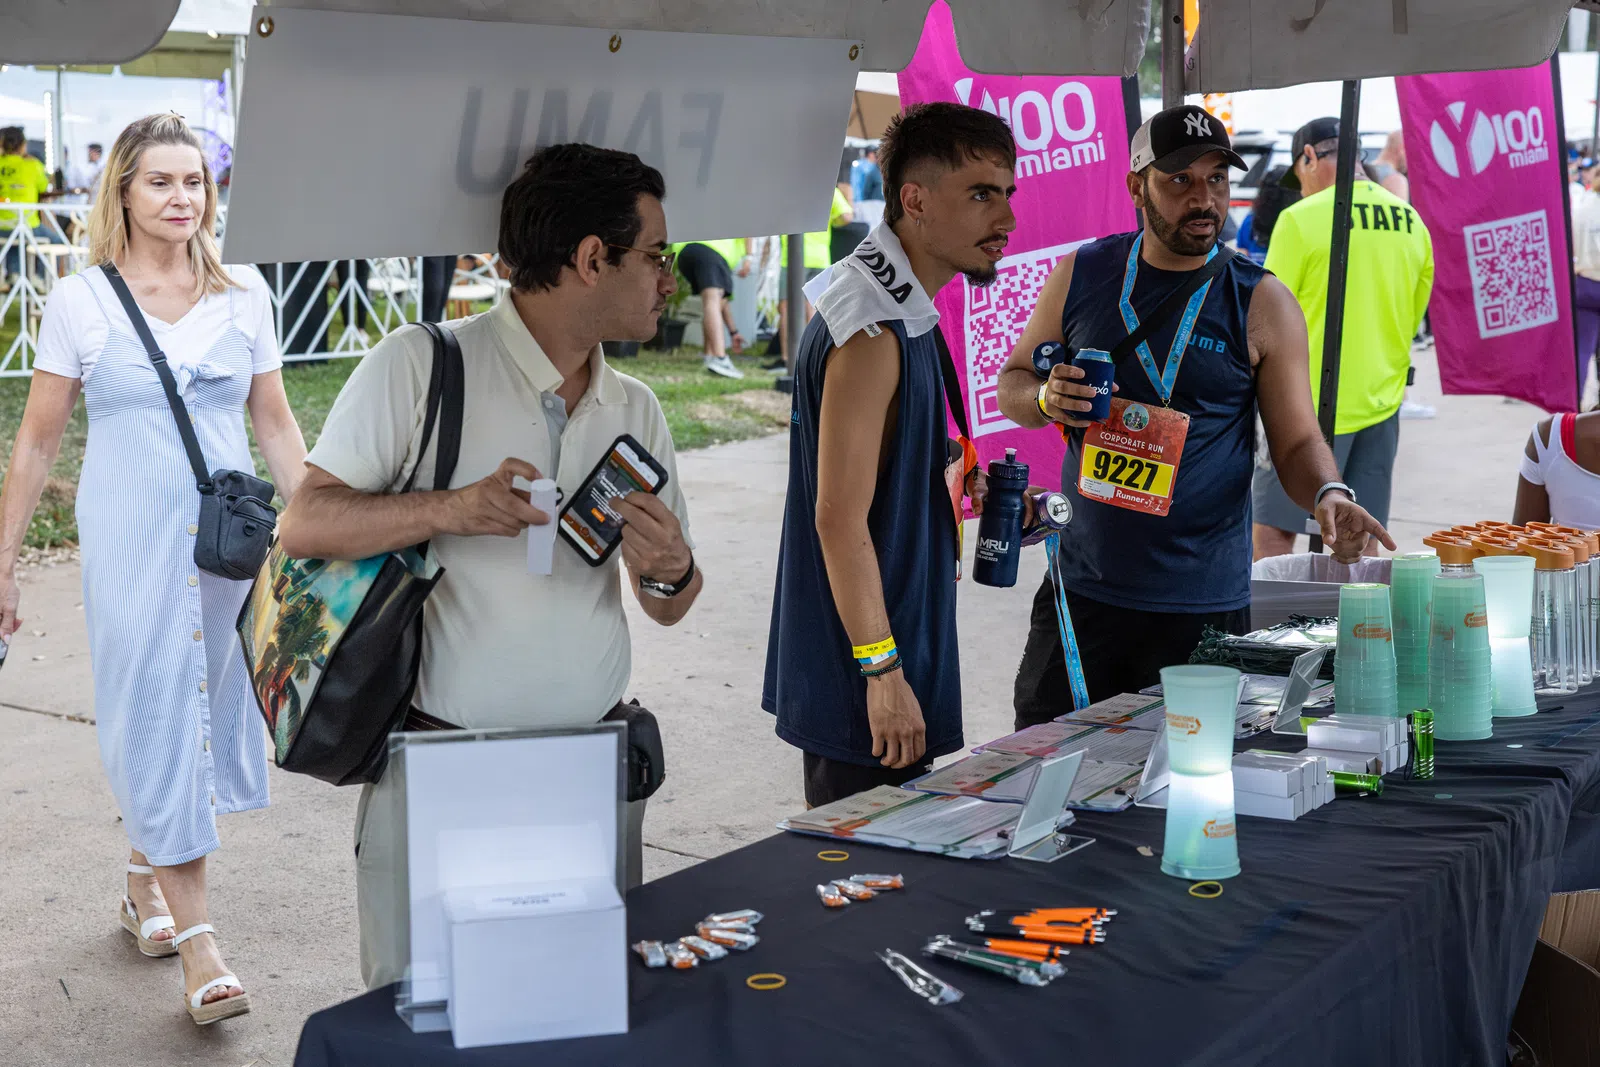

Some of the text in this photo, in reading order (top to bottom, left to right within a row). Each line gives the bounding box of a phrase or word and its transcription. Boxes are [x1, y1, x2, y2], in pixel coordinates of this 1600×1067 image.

[1183, 112, 1213, 137] NY
[1015, 131, 1106, 179] miami
[1508, 140, 1549, 169] miami
[1350, 203, 1414, 234] TAFF
[1188, 334, 1227, 353] uma
[1099, 431, 1146, 450] CORPORATE
[1147, 443, 1164, 454] RUN
[1149, 452, 1163, 460] 2025
[1092, 450, 1160, 492] 9227
[1115, 489, 1146, 505] Runner
